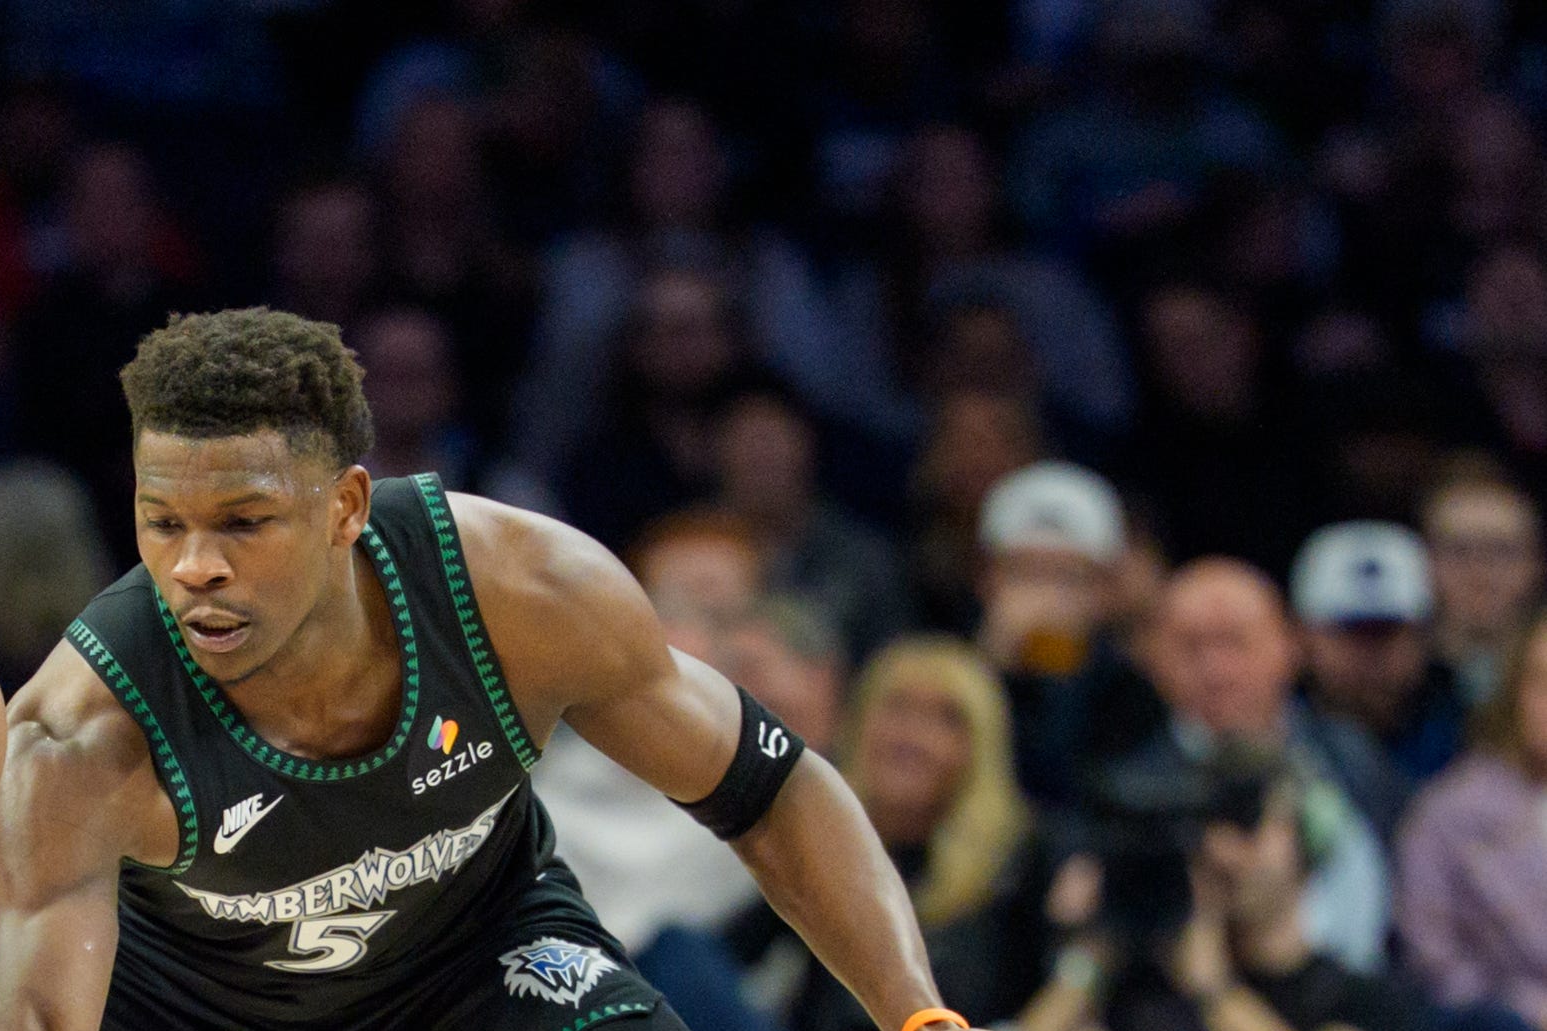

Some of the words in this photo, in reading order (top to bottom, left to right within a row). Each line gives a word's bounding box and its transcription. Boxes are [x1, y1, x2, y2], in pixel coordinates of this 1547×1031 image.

[758, 720, 790, 760] 5
[411, 740, 494, 795] sezzle
[222, 792, 264, 836] NIKE
[264, 909, 398, 974] 5
